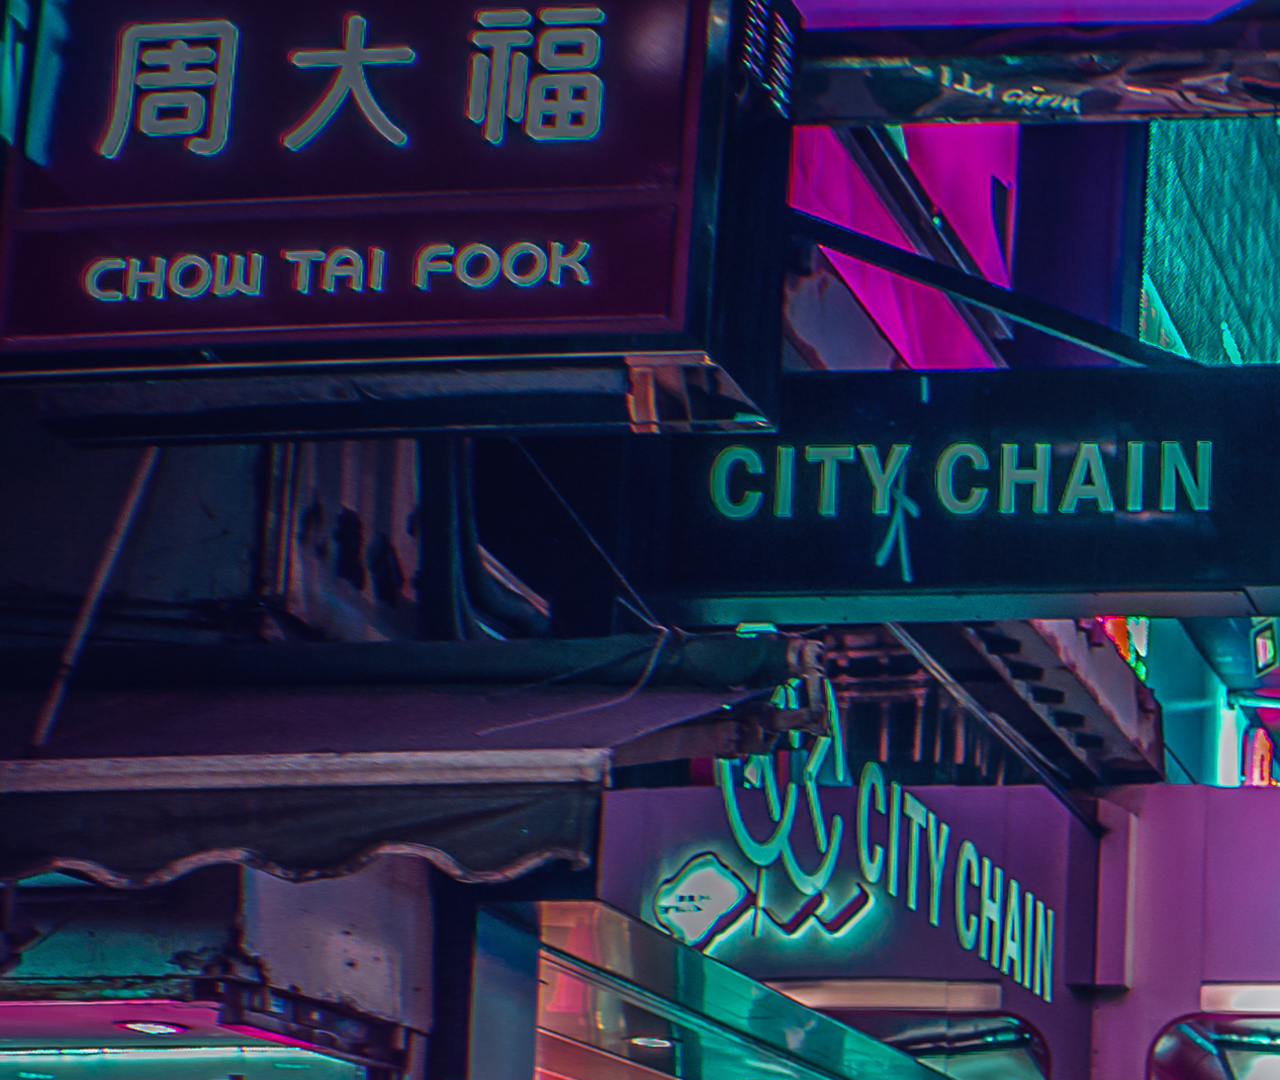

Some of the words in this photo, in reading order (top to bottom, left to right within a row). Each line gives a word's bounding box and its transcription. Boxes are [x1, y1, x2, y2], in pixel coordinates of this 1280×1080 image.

[99, 7, 605, 158] 周大福
[84, 252, 263, 301] CHOW
[282, 247, 386, 294] TAI
[414, 241, 590, 290] FOOK
[710, 441, 911, 519] CITY
[935, 440, 1213, 515] CHAIN
[856, 762, 949, 927] CITY
[955, 840, 1054, 1003] CHAIN
